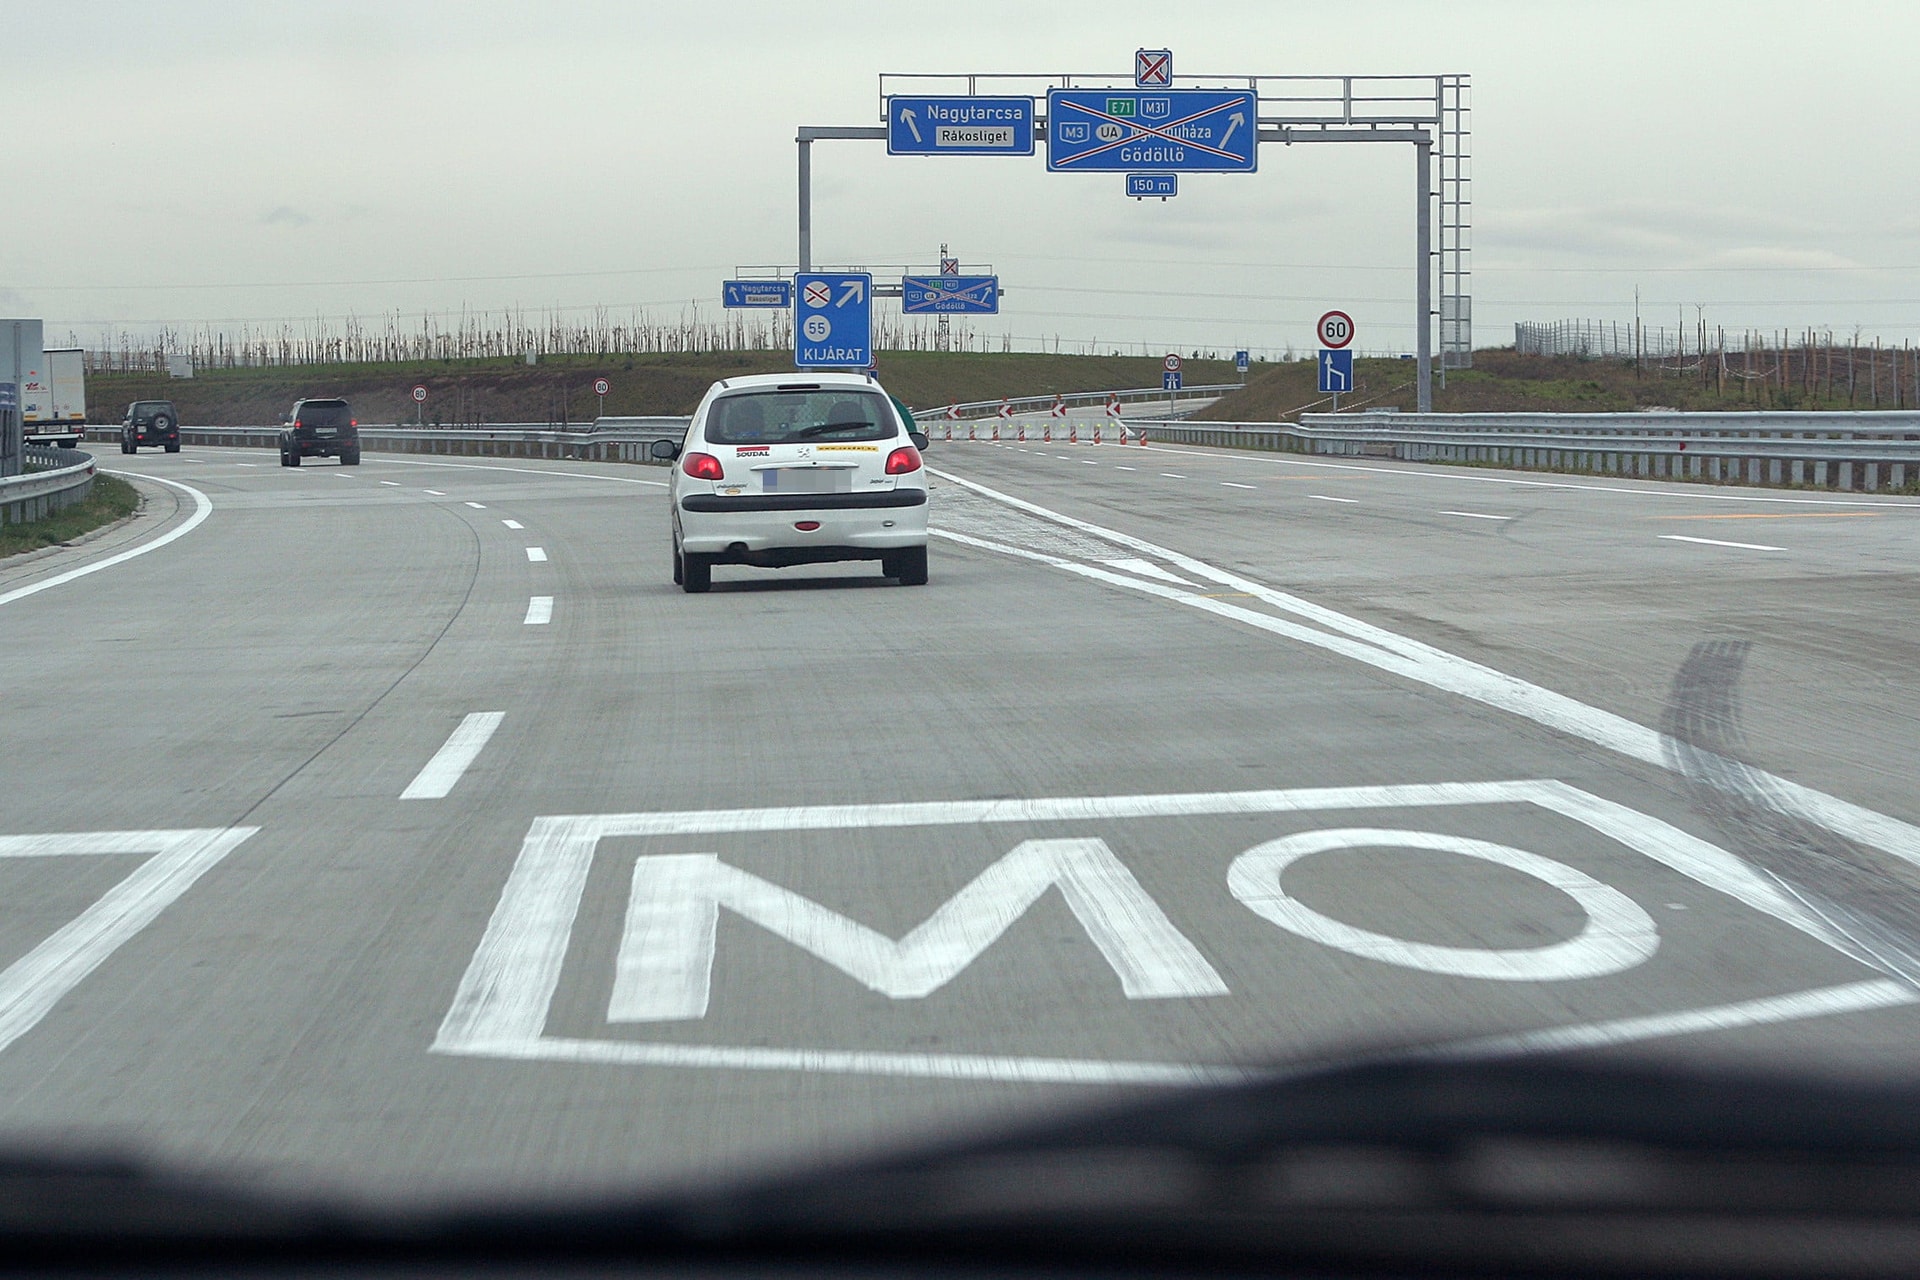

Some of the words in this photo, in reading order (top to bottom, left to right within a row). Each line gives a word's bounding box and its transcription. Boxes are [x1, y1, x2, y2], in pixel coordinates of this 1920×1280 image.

[927, 105, 1023, 123] Nagytarcsa
[1146, 102, 1165, 114] M31
[942, 130, 1008, 144] Rákosliget
[1066, 126, 1084, 138] M3
[1101, 126, 1118, 138] UA
[1131, 124, 1212, 142] Nyígyháza
[1133, 180, 1154, 191] 150
[1158, 182, 1170, 191] m
[741, 284, 785, 294] Nagytarcsa
[808, 322, 826, 334] 55
[1325, 321, 1346, 338] 60
[804, 345, 863, 361] KIJÁRAT
[1167, 358, 1178, 367] 100
